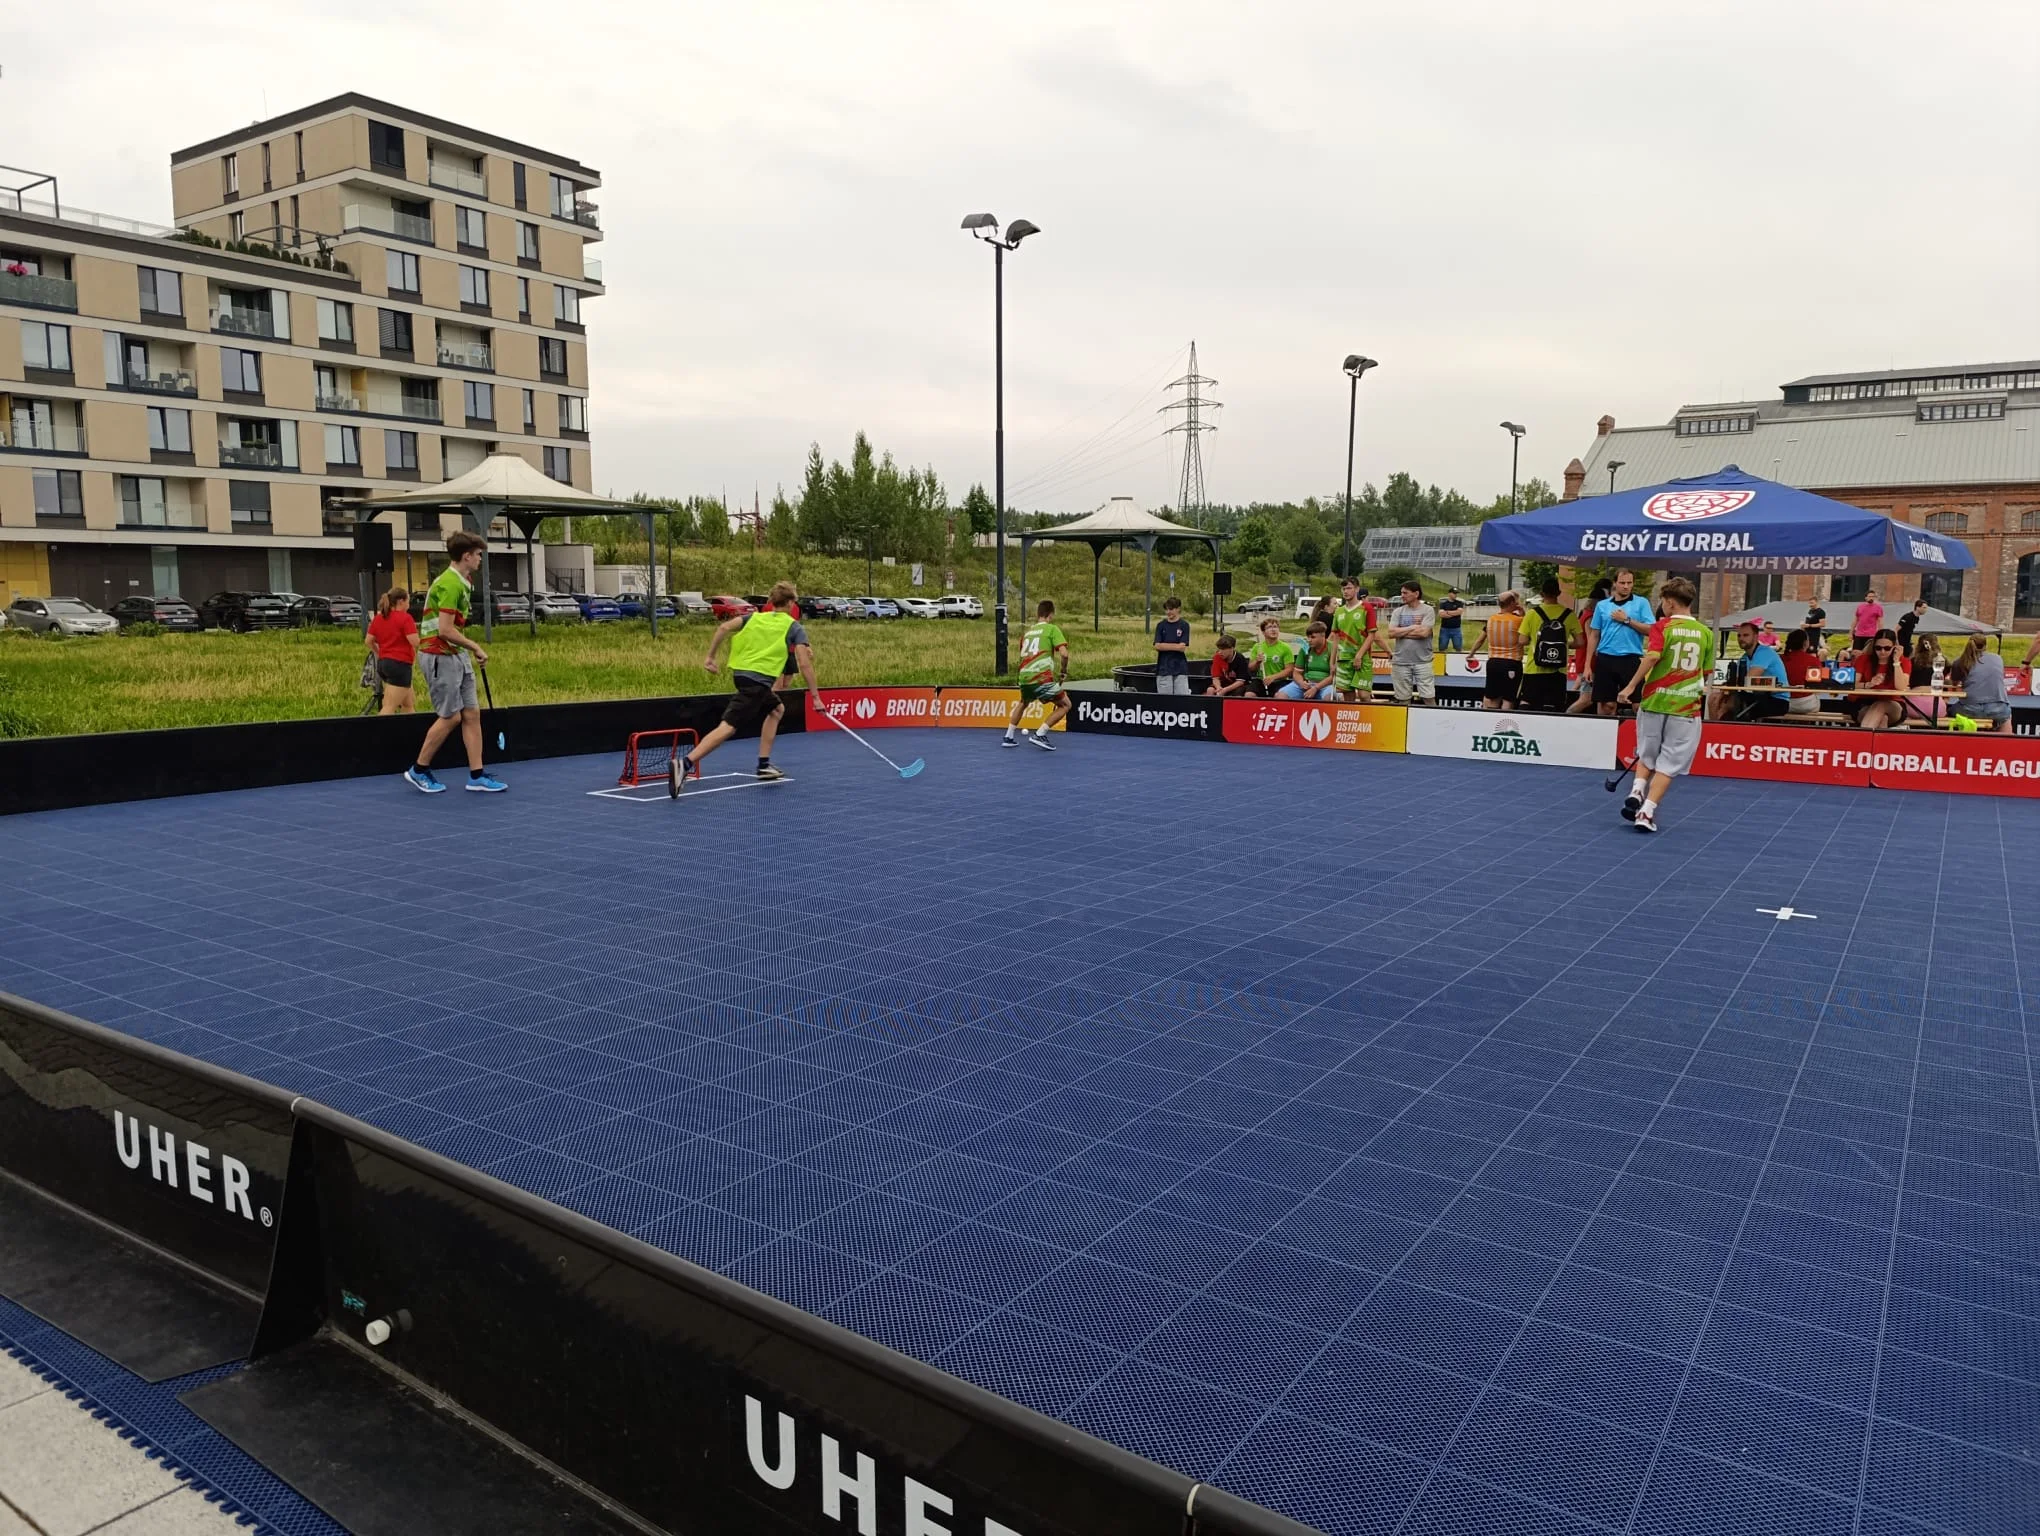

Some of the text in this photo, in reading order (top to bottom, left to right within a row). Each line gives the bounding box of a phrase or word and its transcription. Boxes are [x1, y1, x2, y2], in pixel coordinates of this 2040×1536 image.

[1581, 529, 1754, 551] ČESKÝ FLORBAL
[1670, 641, 1700, 671] 13
[886, 699, 927, 716] BRNO
[944, 699, 1007, 717] OSTRAVA
[1078, 701, 1208, 731] florbalexpert
[1336, 710, 1360, 721] BRNO
[1335, 733, 1357, 744] 2025
[1336, 722, 1372, 733] OSTRAVA
[1472, 735, 1542, 757] HOLBA
[1705, 743, 1746, 761] KFC
[1749, 745, 1828, 766] STREET
[1832, 750, 1961, 774] FLOORBALL
[745, 1394, 1026, 1536] UHE
